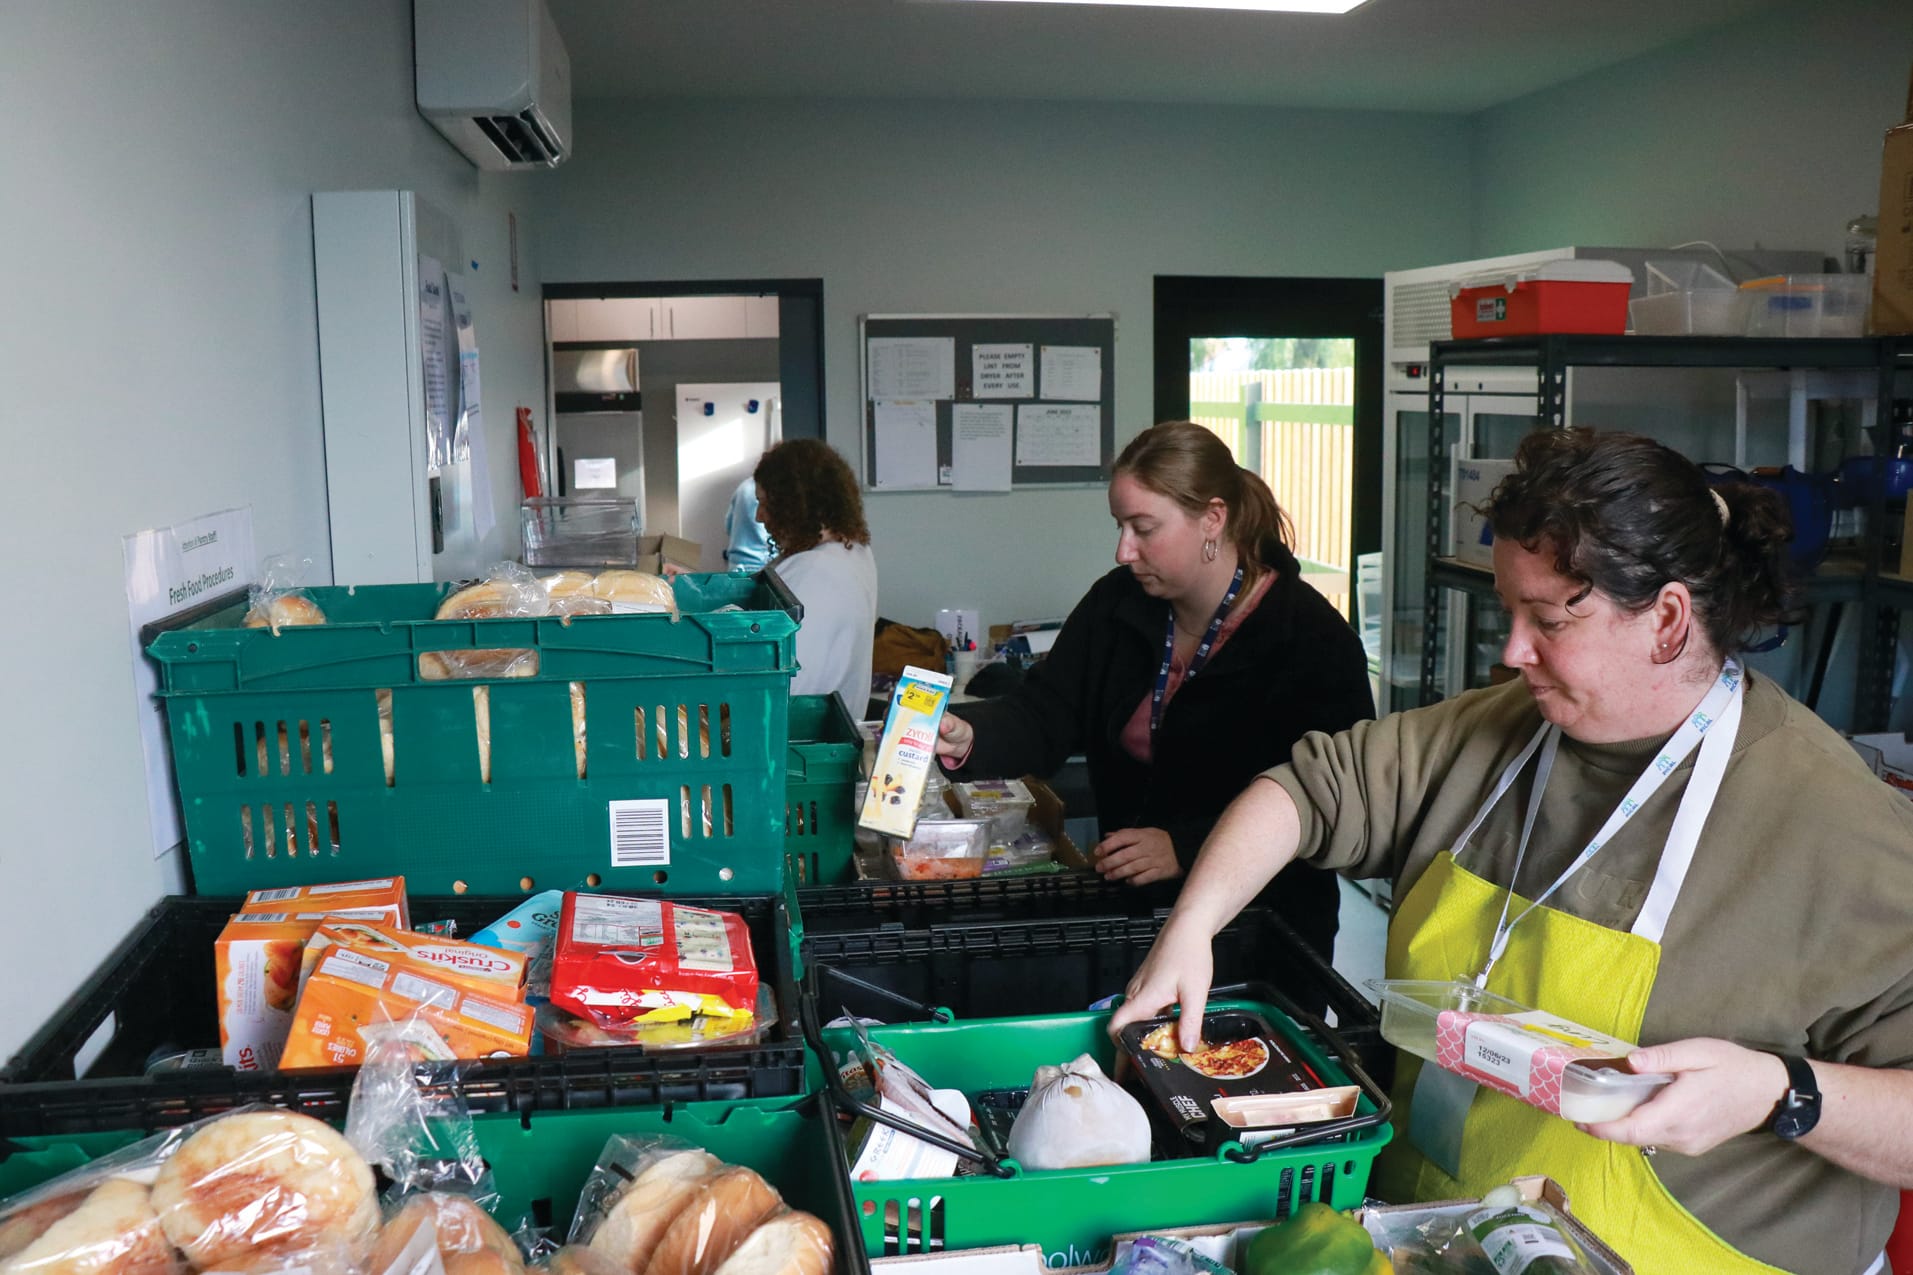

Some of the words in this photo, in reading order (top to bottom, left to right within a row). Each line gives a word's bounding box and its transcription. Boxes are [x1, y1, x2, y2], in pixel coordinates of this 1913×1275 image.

[979, 352, 1001, 360] PLEASE
[1004, 352, 1025, 360] EMPTY
[984, 362, 998, 370] LINT
[1002, 362, 1021, 370] FROM
[980, 372, 1001, 380] DRYER
[169, 583, 187, 606] Fresh
[187, 575, 202, 598] Food
[202, 566, 234, 591] Procedures
[898, 749, 929, 763] custard
[444, 946, 490, 959] Original
[416, 949, 511, 973] Cruskits
[1477, 1051, 1501, 1066] 15323
[1478, 1045, 1511, 1064] 12/06/23
[1178, 1095, 1207, 1118] CHEF
